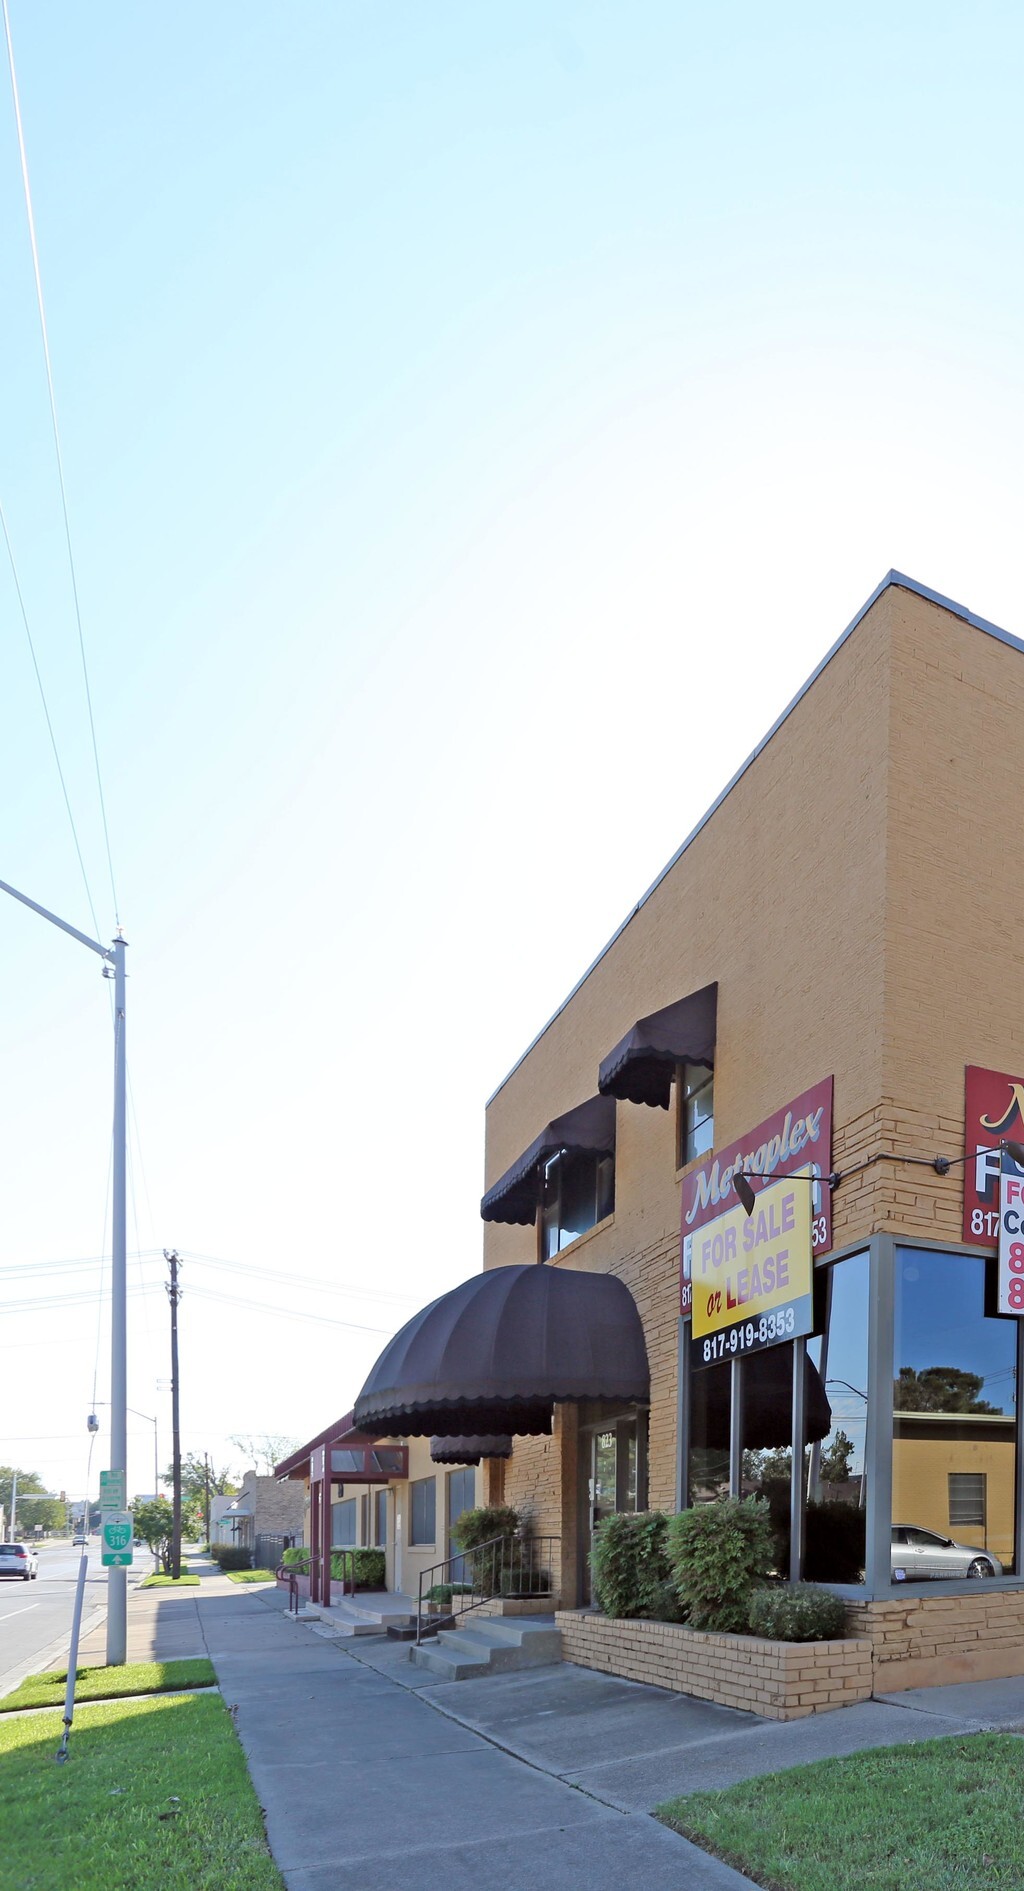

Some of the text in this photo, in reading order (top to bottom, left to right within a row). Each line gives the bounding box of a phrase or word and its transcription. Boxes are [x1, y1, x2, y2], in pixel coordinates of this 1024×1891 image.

[685, 1106, 825, 1225] Metroplex
[701, 1225, 737, 1275] FOR
[742, 1192, 796, 1252] SALE
[706, 1290, 722, 1318] or
[726, 1249, 790, 1311] LEASE
[703, 1307, 795, 1362] 817-919-8353
[602, 1432, 612, 1448] 823
[109, 1535, 127, 1547] 316
